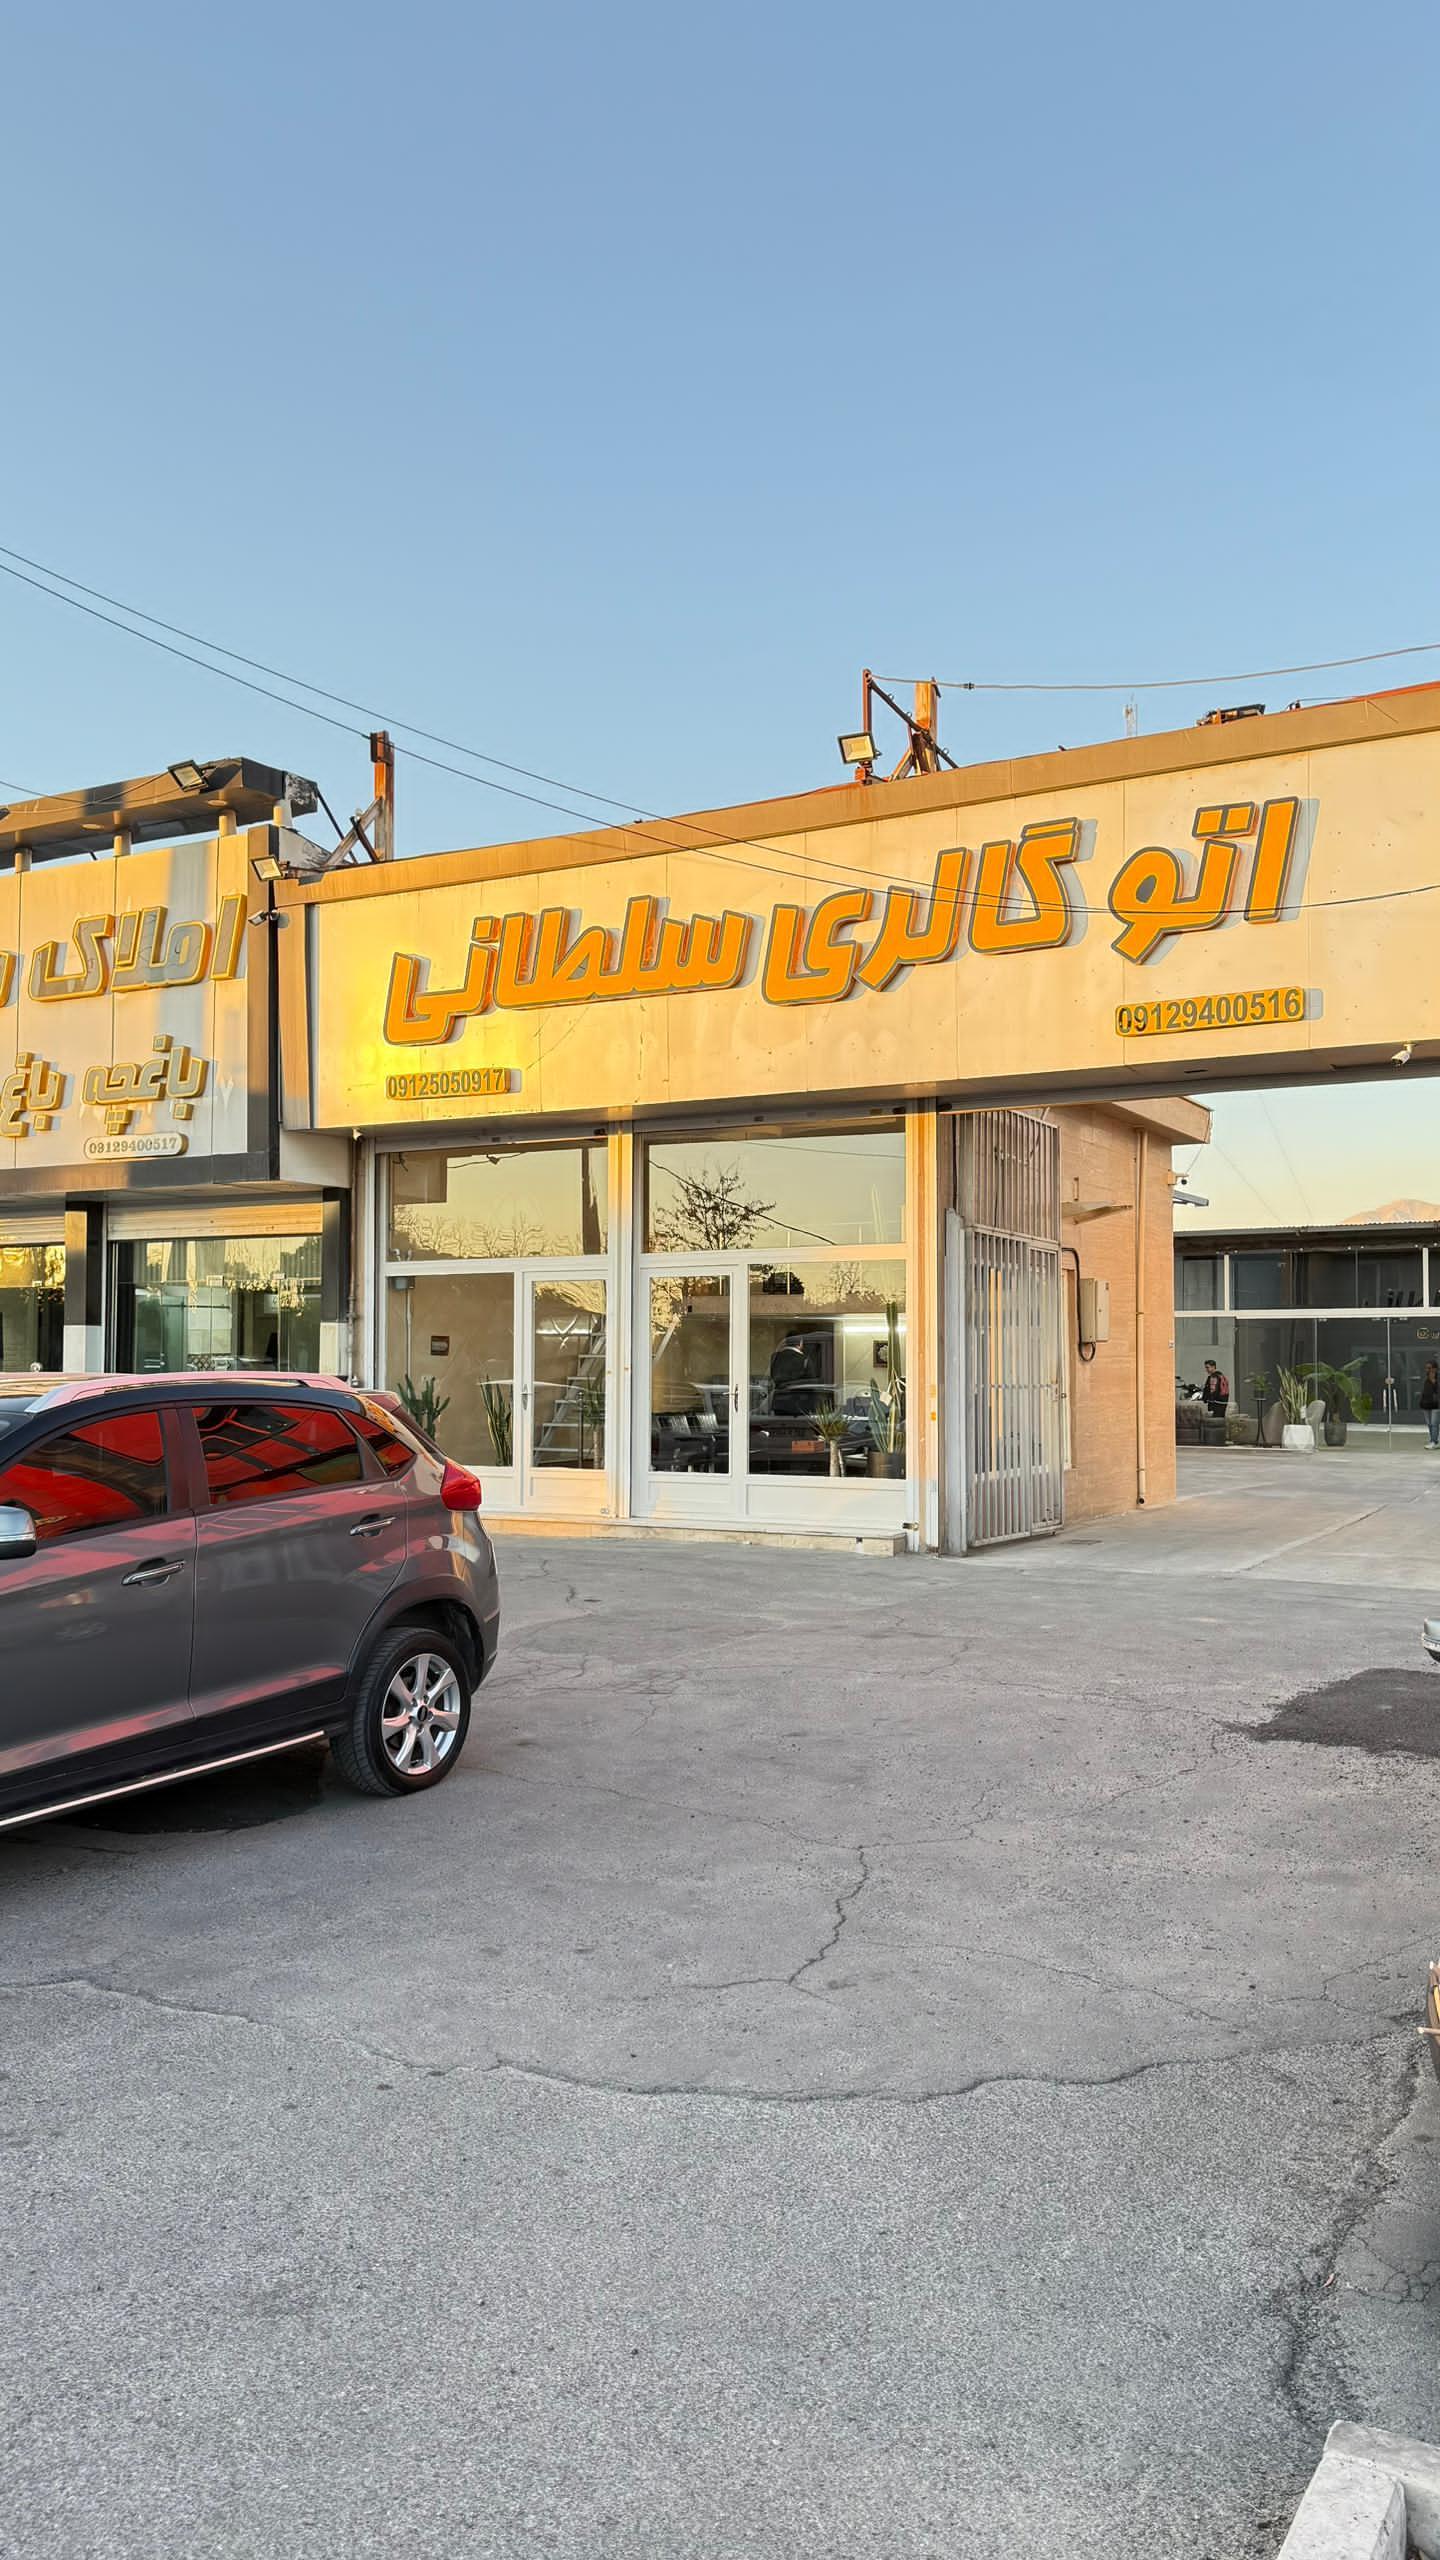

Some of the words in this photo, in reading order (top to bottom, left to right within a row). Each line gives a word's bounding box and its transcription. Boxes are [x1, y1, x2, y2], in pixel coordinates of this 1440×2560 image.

[761, 816, 1082, 1006] گالری
[1108, 796, 1302, 965] اتو
[28, 893, 247, 1001] املاک
[383, 894, 754, 1047] سلطانی
[1118, 988, 1301, 1034] 09129400516
[82, 1034, 209, 1136] باغچه
[387, 1068, 504, 1098] 09125050917
